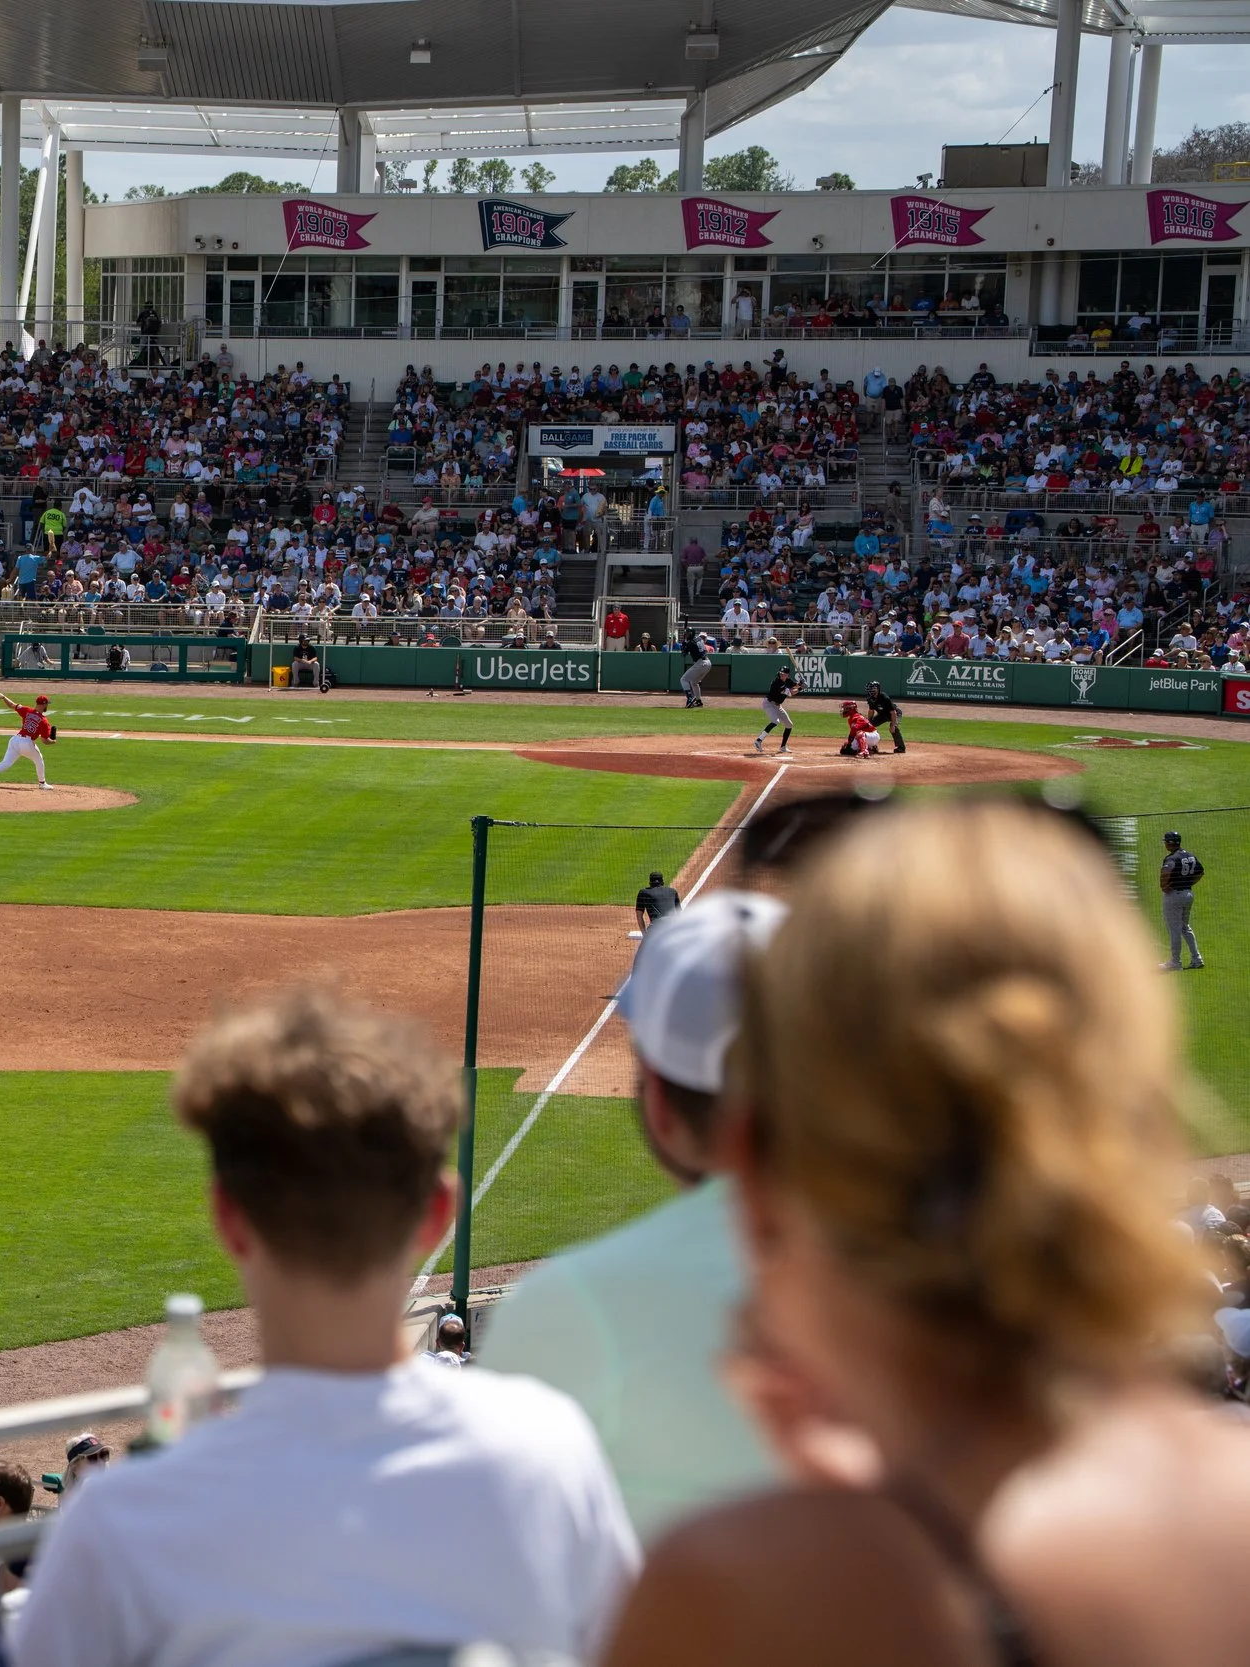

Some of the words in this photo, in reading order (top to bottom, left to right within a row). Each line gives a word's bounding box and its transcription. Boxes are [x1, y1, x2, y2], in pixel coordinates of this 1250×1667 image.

[696, 203, 722, 212] WORLD
[724, 208, 748, 219] SERIES
[906, 201, 934, 210] WORLD
[935, 206, 961, 217] SERIES
[1162, 196, 1189, 204] WORLD
[1191, 200, 1217, 211] SERIES
[297, 205, 322, 214] WORLD
[324, 209, 348, 220] SERIES
[493, 205, 522, 215] AMERICAN
[523, 210, 544, 220] LEAGUE
[1163, 203, 1216, 230] 1916
[296, 212, 349, 240] 1903
[492, 212, 545, 240] 1904
[698, 210, 748, 237] 1912
[908, 208, 960, 236] 1915
[699, 232, 746, 245] CHAMPIONS
[909, 230, 958, 244] CHAMPIONS
[1164, 226, 1213, 238] CHAMPIONS
[300, 233, 345, 247] CHAMPIONS
[495, 233, 542, 247] CHAMPIONS
[542, 433, 591, 442] BALLGAME
[611, 433, 627, 441] FREE
[628, 433, 648, 441] PACK
[649, 433, 657, 441] OF
[604, 441, 638, 449] BASEBALL
[639, 441, 663, 449] CARDS
[47, 512, 60, 521] 290
[476, 656, 590, 685] UberJets
[795, 656, 827, 672] KICK
[795, 673, 842, 688] STAND
[947, 665, 1006, 681] AZTEC
[1149, 677, 1188, 691] jetBlue
[1190, 680, 1218, 691] Park
[1181, 856, 1196, 876] 67
